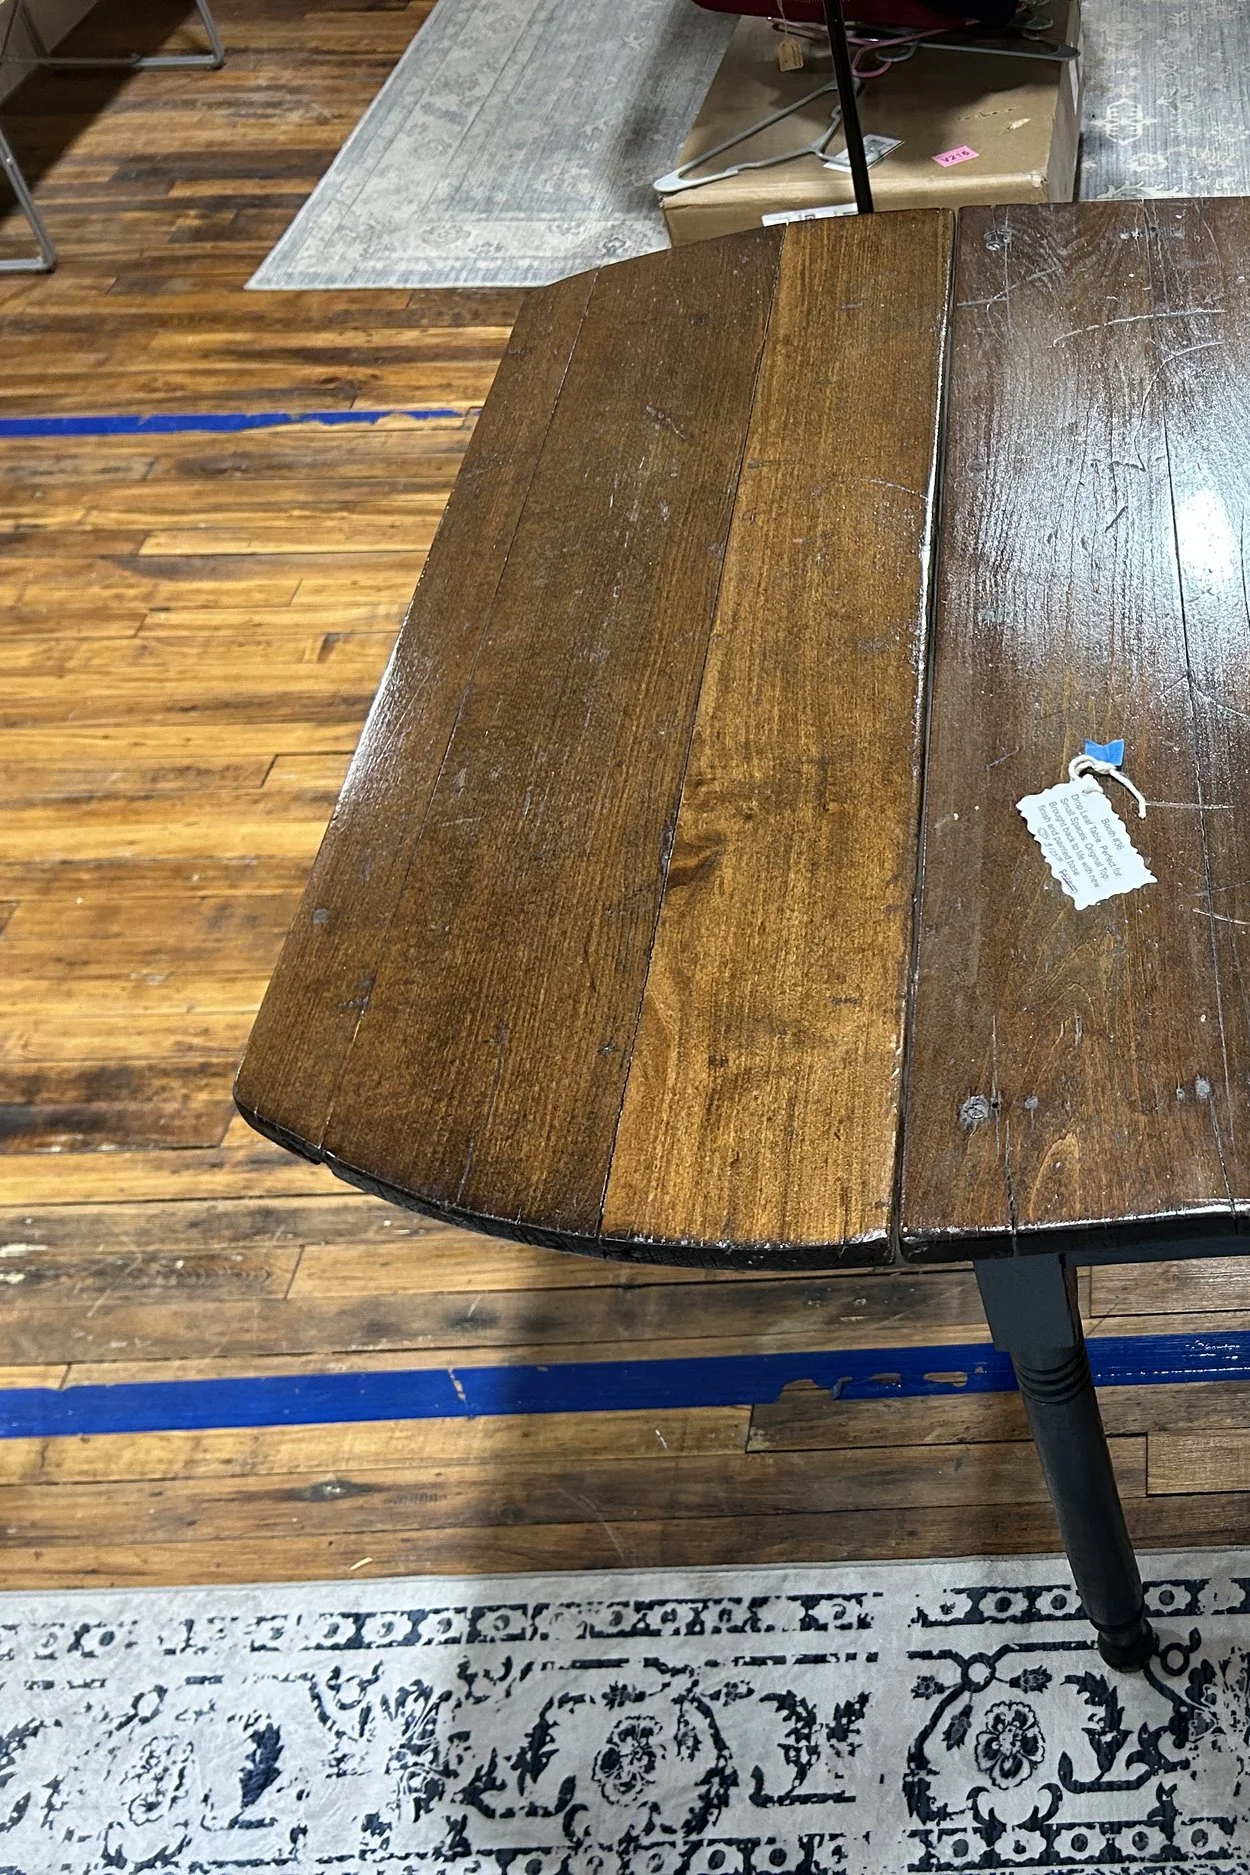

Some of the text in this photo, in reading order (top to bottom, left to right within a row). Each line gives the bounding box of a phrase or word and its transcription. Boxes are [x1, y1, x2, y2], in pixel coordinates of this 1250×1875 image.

[1037, 805, 1051, 823] finish
[1052, 836, 1073, 860] painted
[1048, 801, 1067, 828] Brought
[1062, 826, 1076, 844] back
[1081, 861, 1093, 875] with
[1060, 797, 1076, 817] Small
[1084, 842, 1104, 868] Original
[1070, 793, 1084, 811] Drop
[1079, 810, 1094, 825] Leaf
[1099, 844, 1117, 868] Perfect
[1101, 818, 1116, 838] Booth
